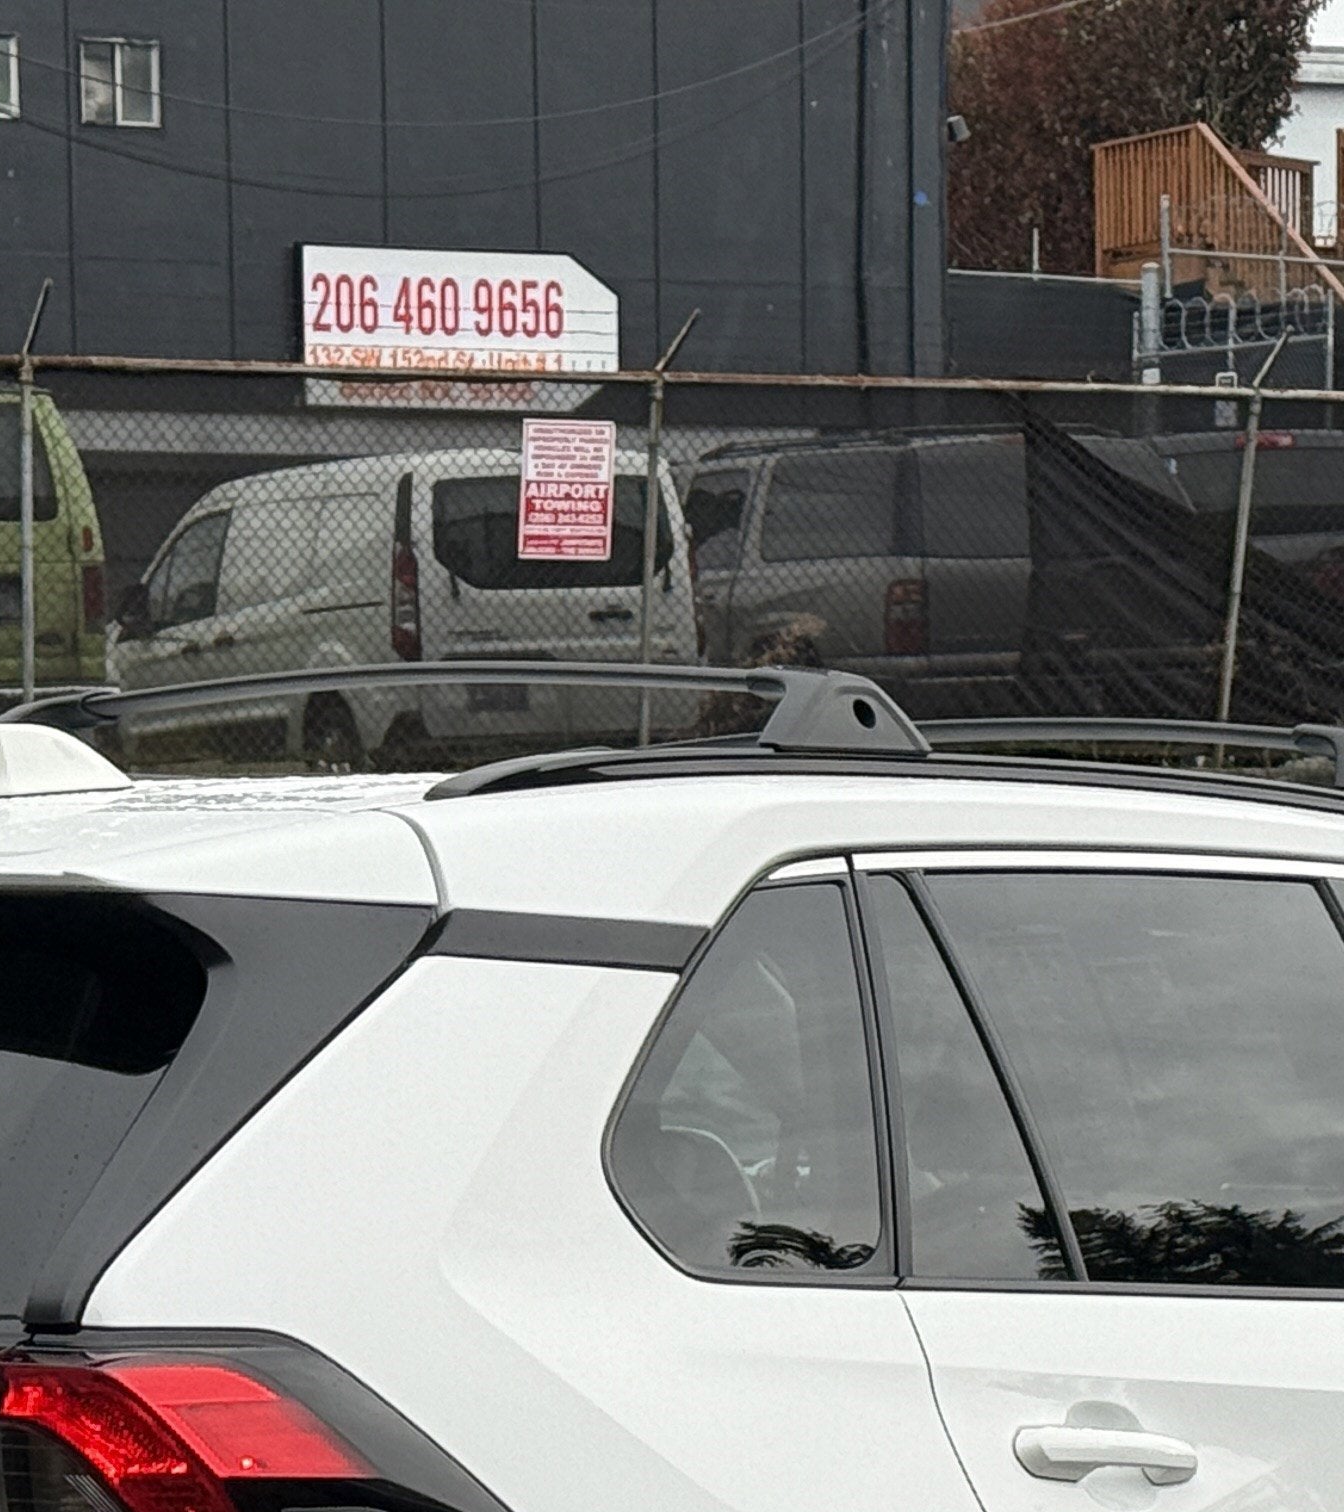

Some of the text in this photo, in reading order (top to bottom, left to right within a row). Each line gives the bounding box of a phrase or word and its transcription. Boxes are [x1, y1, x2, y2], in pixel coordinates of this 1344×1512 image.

[311, 273, 565, 339] 206 460 9656
[525, 482, 610, 499] AIRPORT
[530, 499, 602, 513] TOWING
